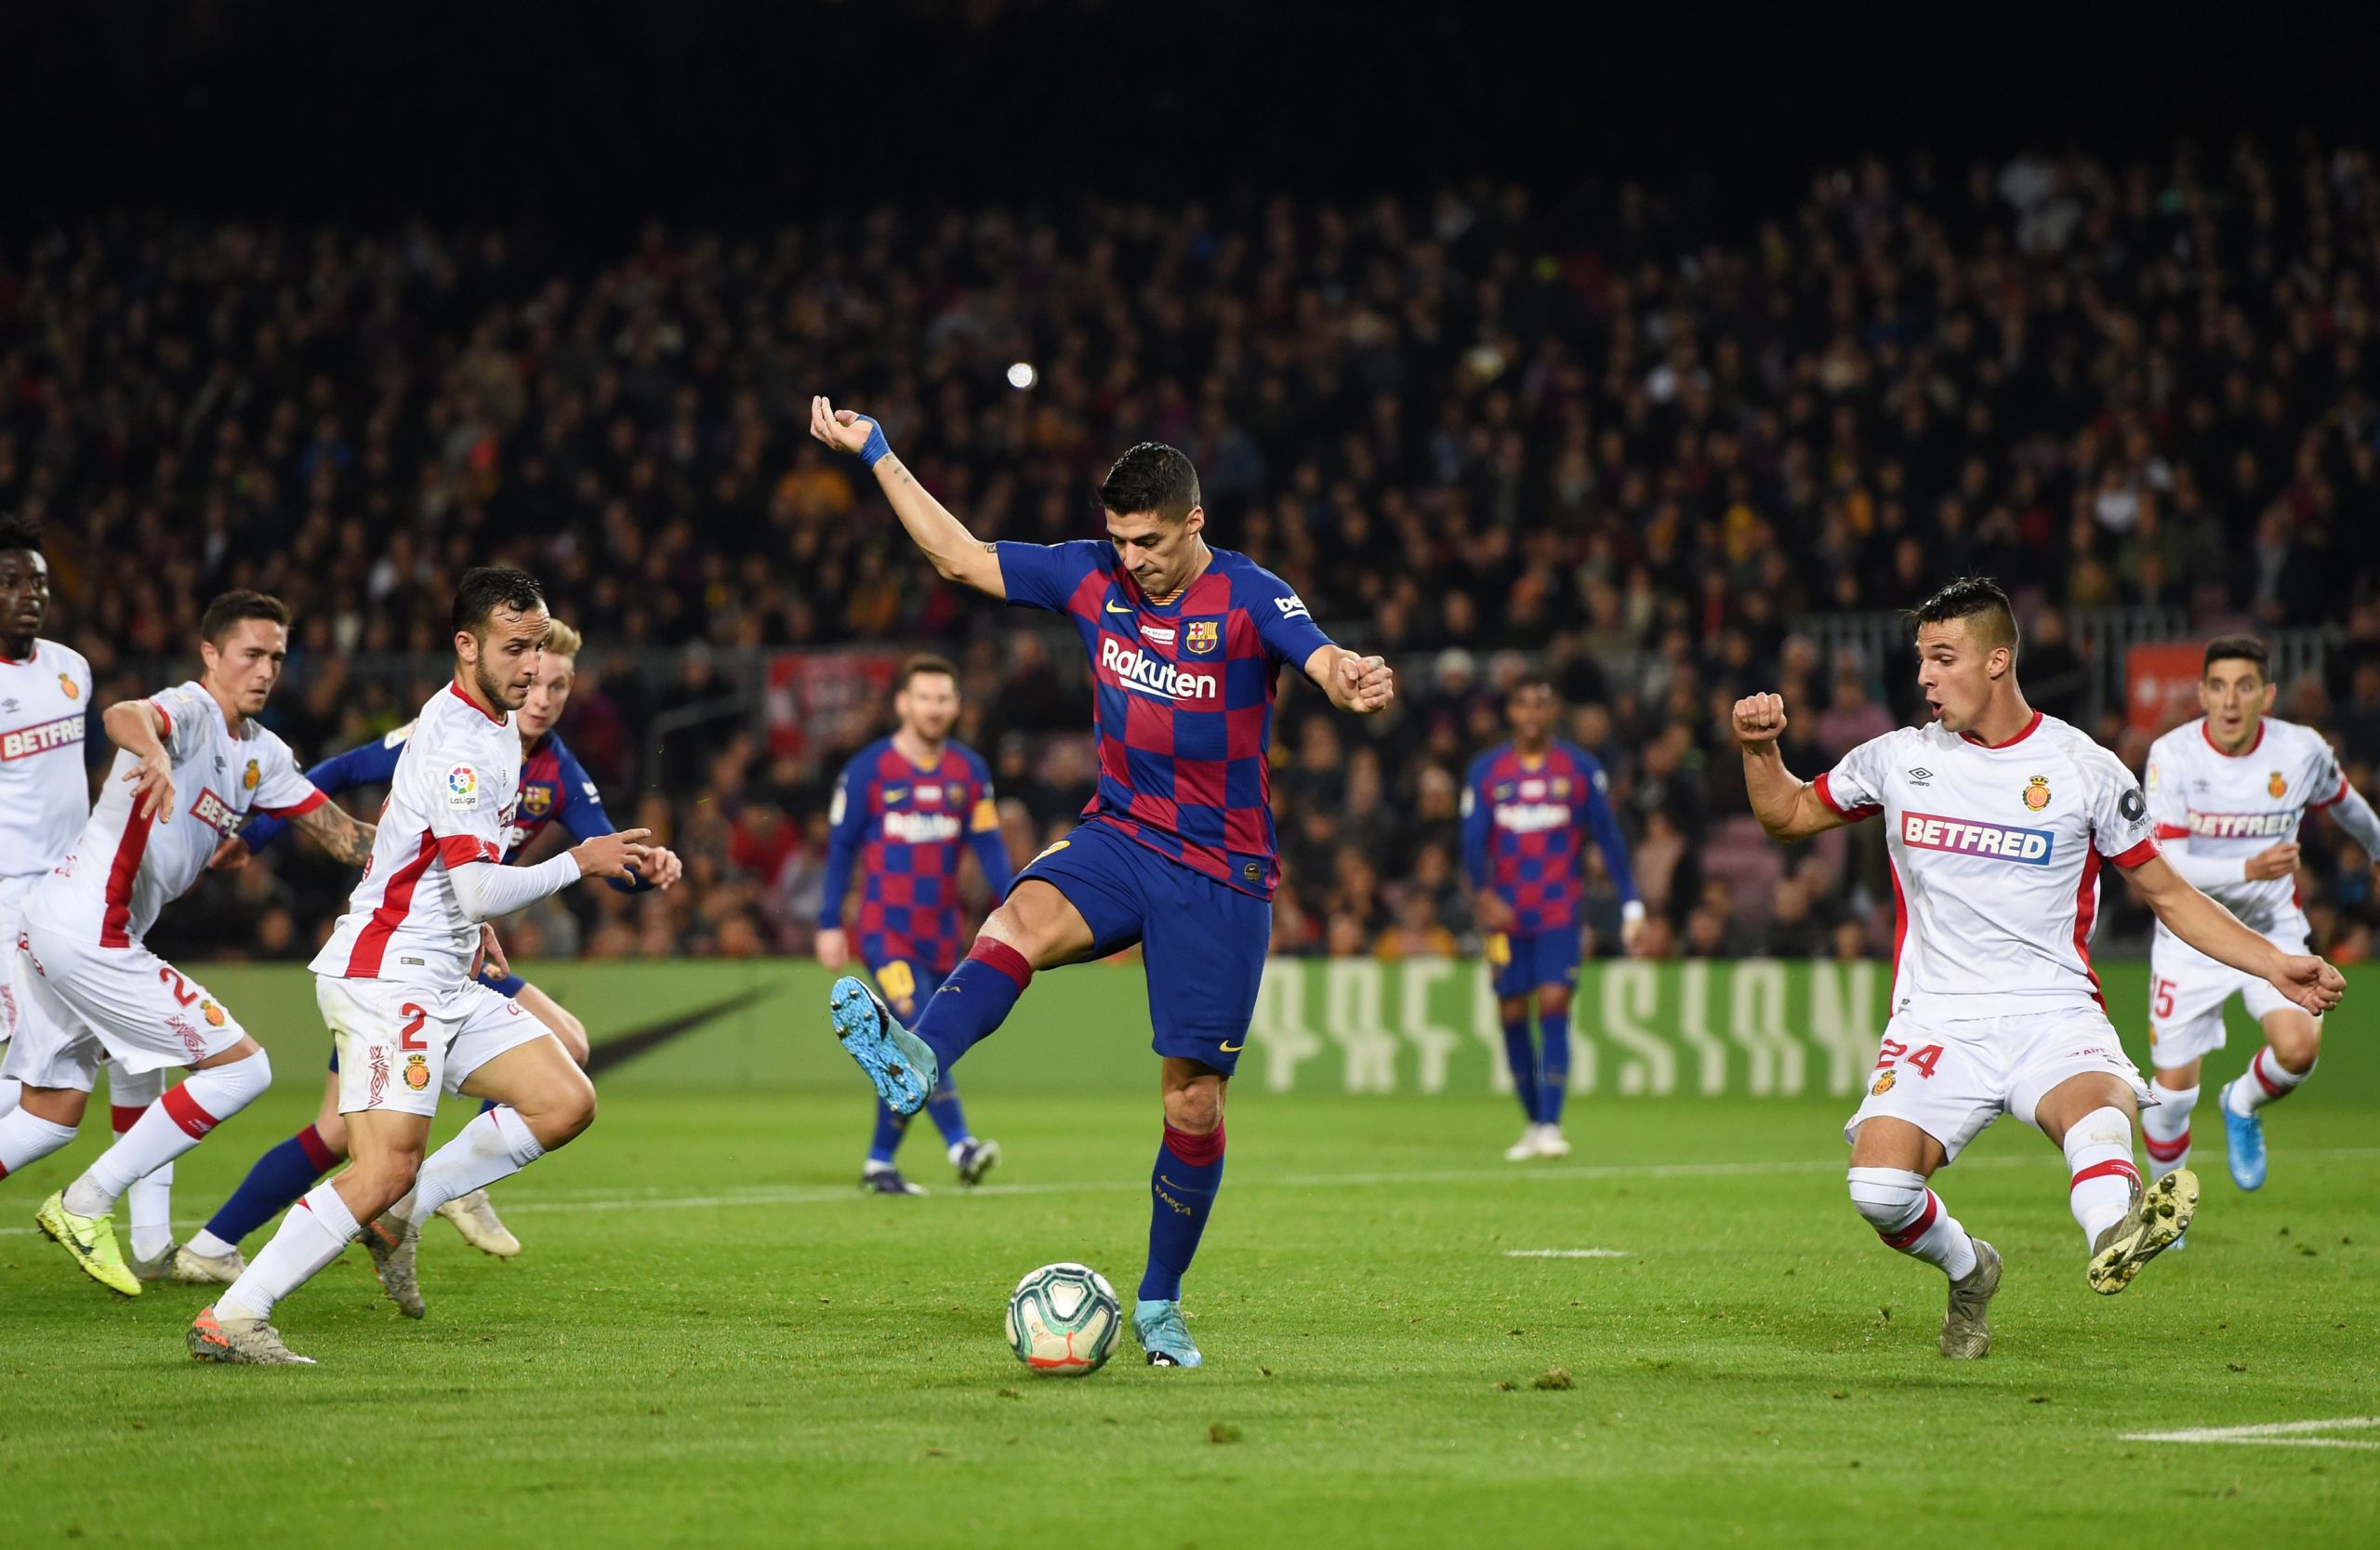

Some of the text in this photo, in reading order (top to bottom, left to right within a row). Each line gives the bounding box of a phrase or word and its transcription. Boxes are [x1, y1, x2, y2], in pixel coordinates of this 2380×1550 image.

[1102, 637, 1216, 699] Rakuten
[450, 797, 476, 805] LaLiga
[1906, 816, 2047, 859] BETFRED
[399, 1002, 429, 1052] 2
[1875, 1039, 1945, 1080] 24
